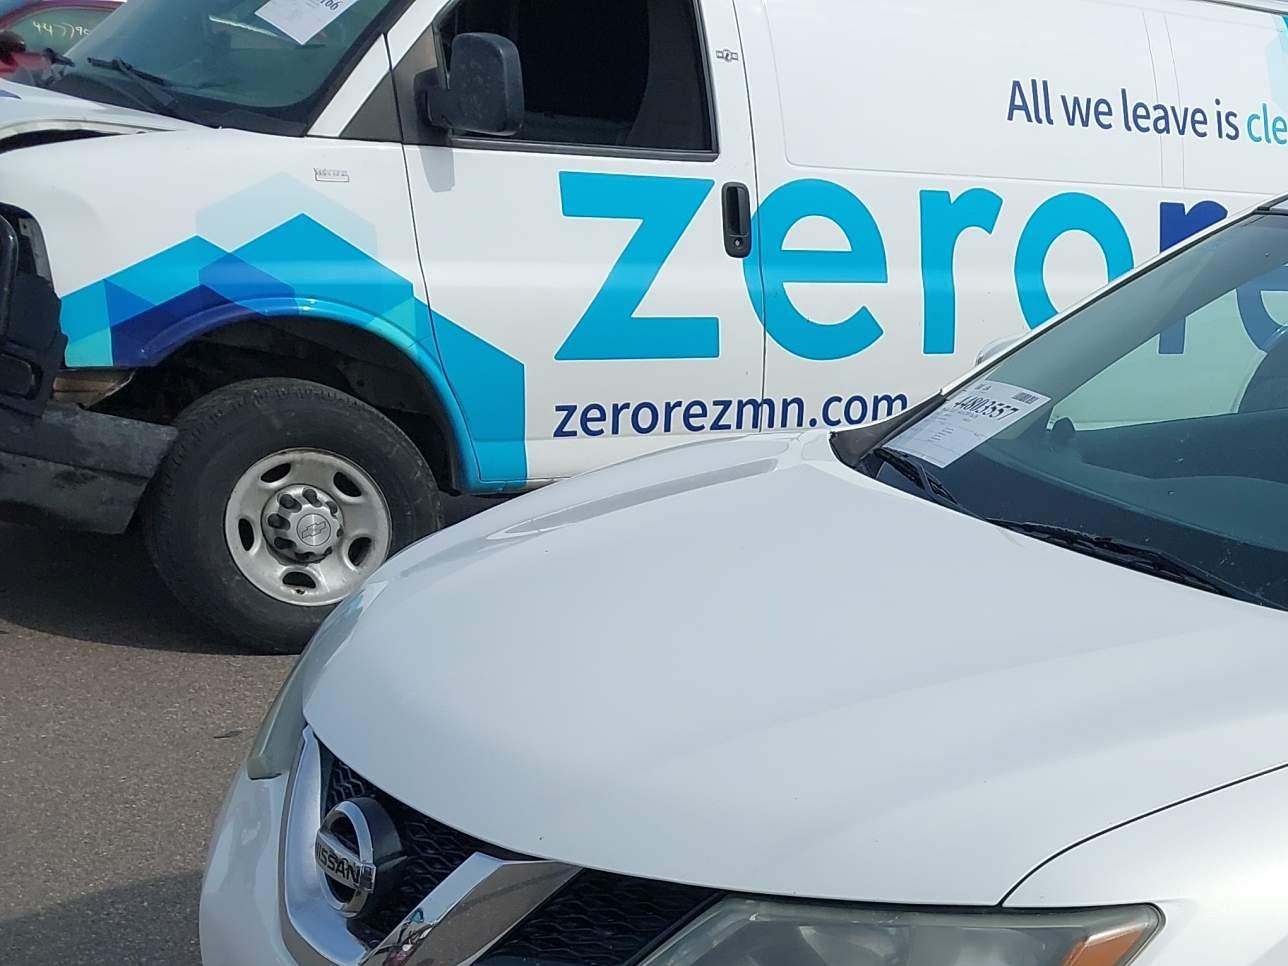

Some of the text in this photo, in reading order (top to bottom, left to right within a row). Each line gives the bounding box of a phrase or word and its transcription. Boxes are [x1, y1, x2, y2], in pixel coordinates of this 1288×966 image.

[1006, 79, 1054, 125] All
[1060, 94, 1113, 130] we
[1121, 88, 1208, 138] leave
[1215, 99, 1240, 140] is
[553, 392, 908, 438] zerorezmn.com
